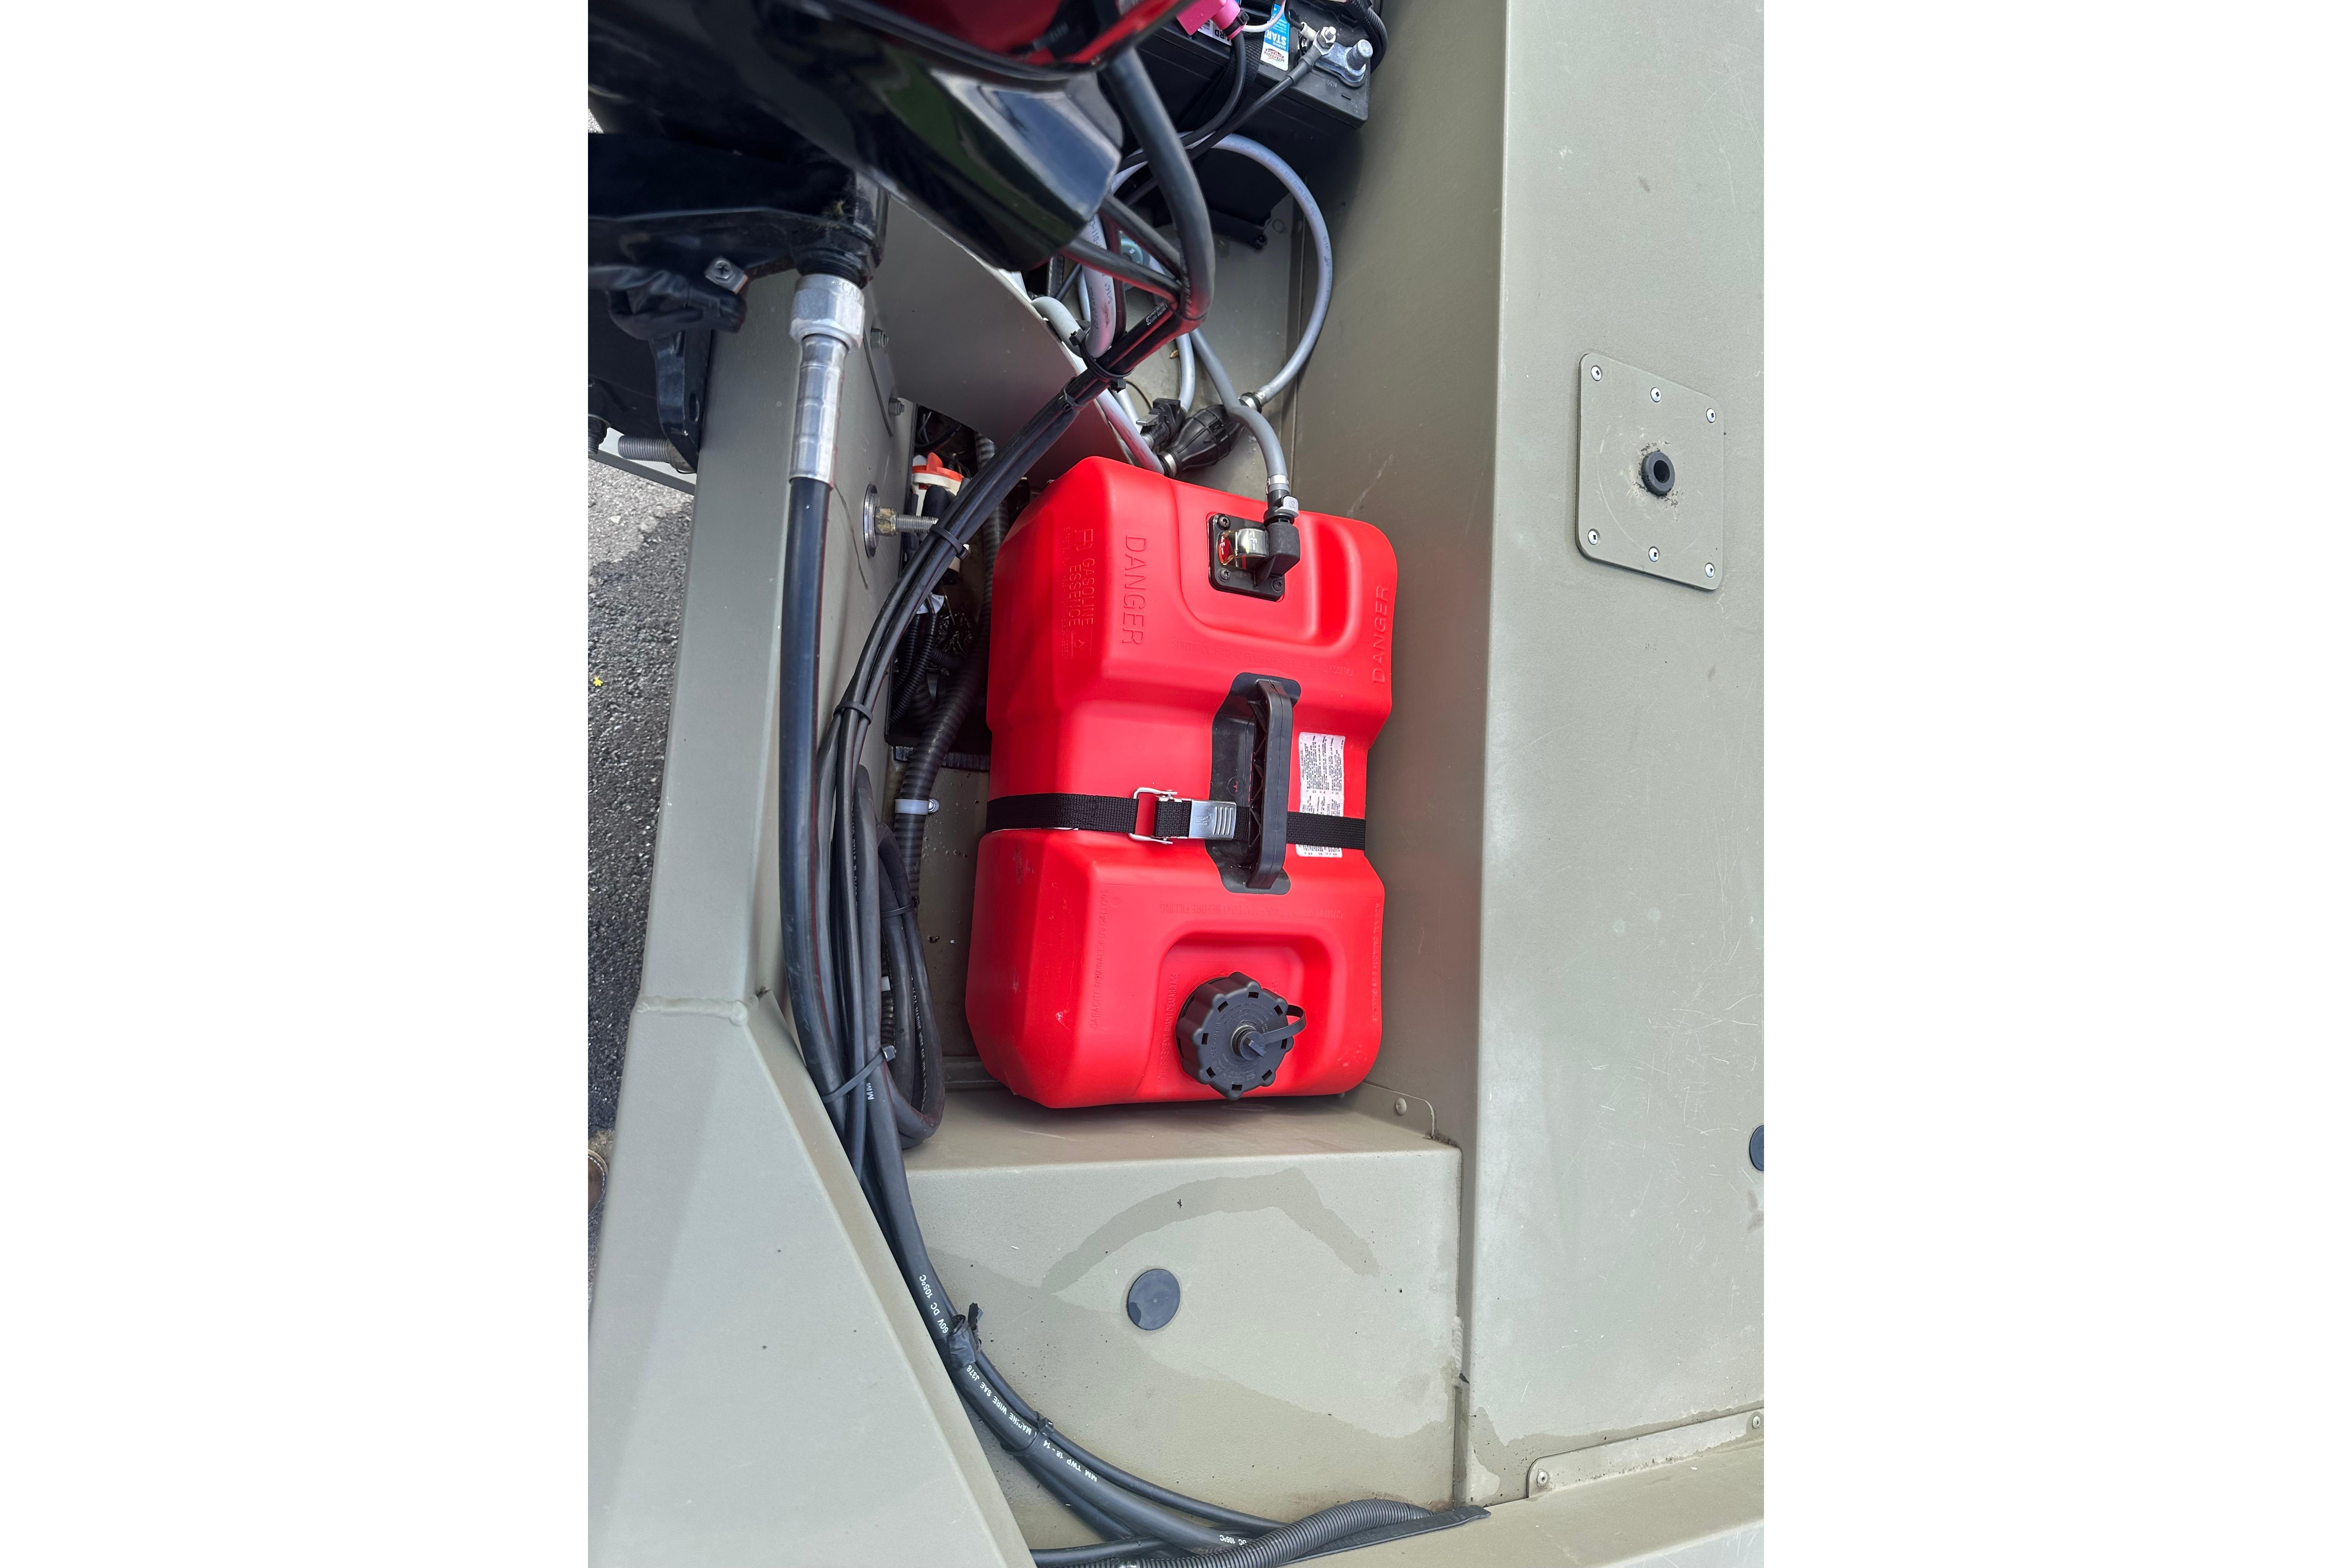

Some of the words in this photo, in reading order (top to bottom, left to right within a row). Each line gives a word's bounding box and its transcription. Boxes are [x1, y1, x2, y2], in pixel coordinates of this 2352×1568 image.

[1264, 51, 1285, 62] INTERSTATE
[1265, 49, 1284, 58] BATTERIES
[1069, 564, 1082, 626] ESSENCE
[1082, 558, 1095, 626] GASOLINE
[1122, 535, 1147, 645] DANGER
[1372, 585, 1389, 685] DANGER
[1171, 640, 1199, 651] SORTIR
[1099, 888, 1108, 926] GALLONS
[1160, 903, 1189, 914] FILLING
[1192, 903, 1220, 915] BEFORE
[1223, 905, 1242, 915] BOAT
[1095, 946, 1105, 987] NOMINALE
[1211, 1022, 1220, 1049] SCEPTER
[930, 1302, 941, 1317] DC
[937, 1318, 949, 1334] 60V
[966, 1364, 980, 1382] J378
[980, 1381, 992, 1397] SAE
[992, 1395, 1008, 1414] WIRE
[1042, 1439, 1051, 1449] 14
[1066, 1458, 1082, 1472] TWP
[1084, 1469, 1097, 1483] MM
